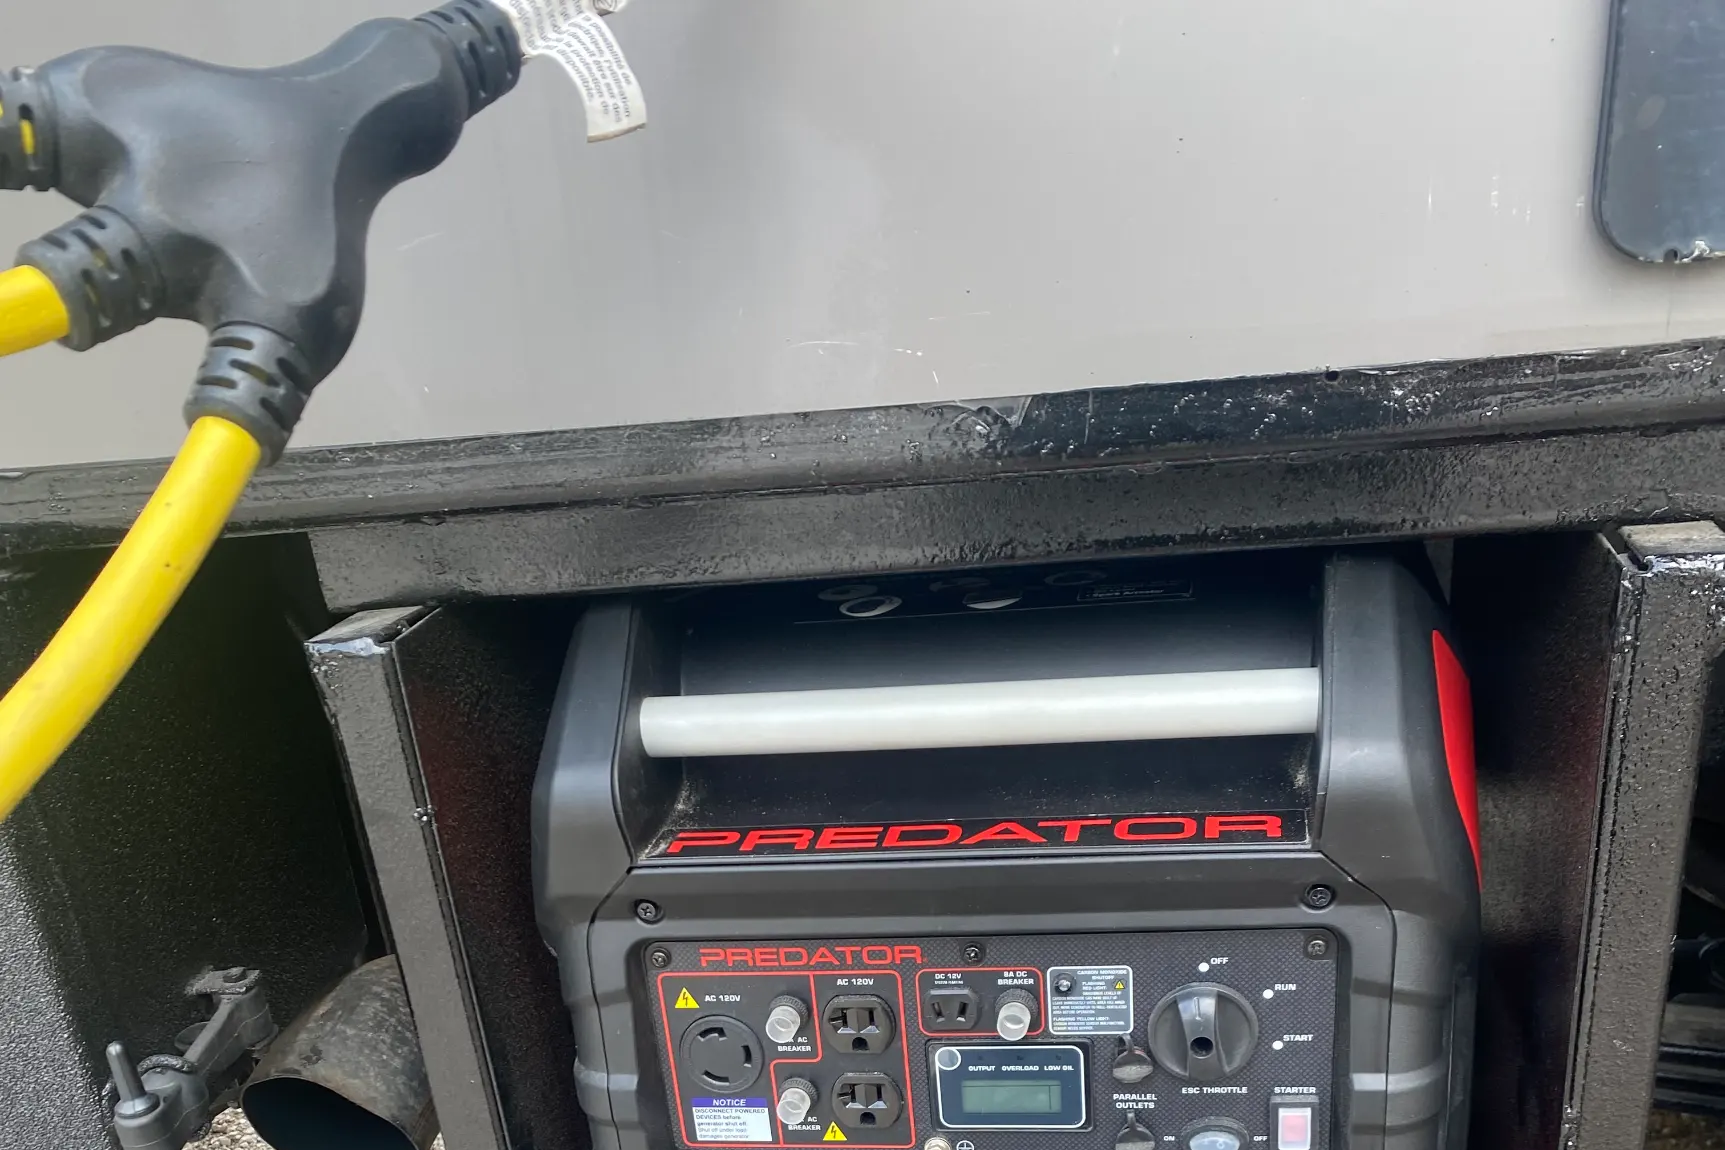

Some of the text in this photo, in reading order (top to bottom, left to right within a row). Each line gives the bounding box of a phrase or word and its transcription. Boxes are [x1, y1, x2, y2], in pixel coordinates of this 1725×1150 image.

[668, 815, 1282, 853] PREDATOR
[699, 945, 923, 967] PREDATOR
[1210, 957, 1229, 965] OFF
[836, 978, 875, 986] AC 120V
[997, 978, 1035, 986] BREAKER
[1274, 983, 1297, 991] RUN
[704, 994, 741, 1002] AC 120V
[1282, 1034, 1314, 1042] START
[1202, 1086, 1248, 1094] THROTTLE
[1273, 1086, 1317, 1094] STARTER
[1112, 1093, 1158, 1101] PARALLEL
[712, 1098, 747, 1106] NOTICE
[1115, 1101, 1155, 1109] OUTLETS
